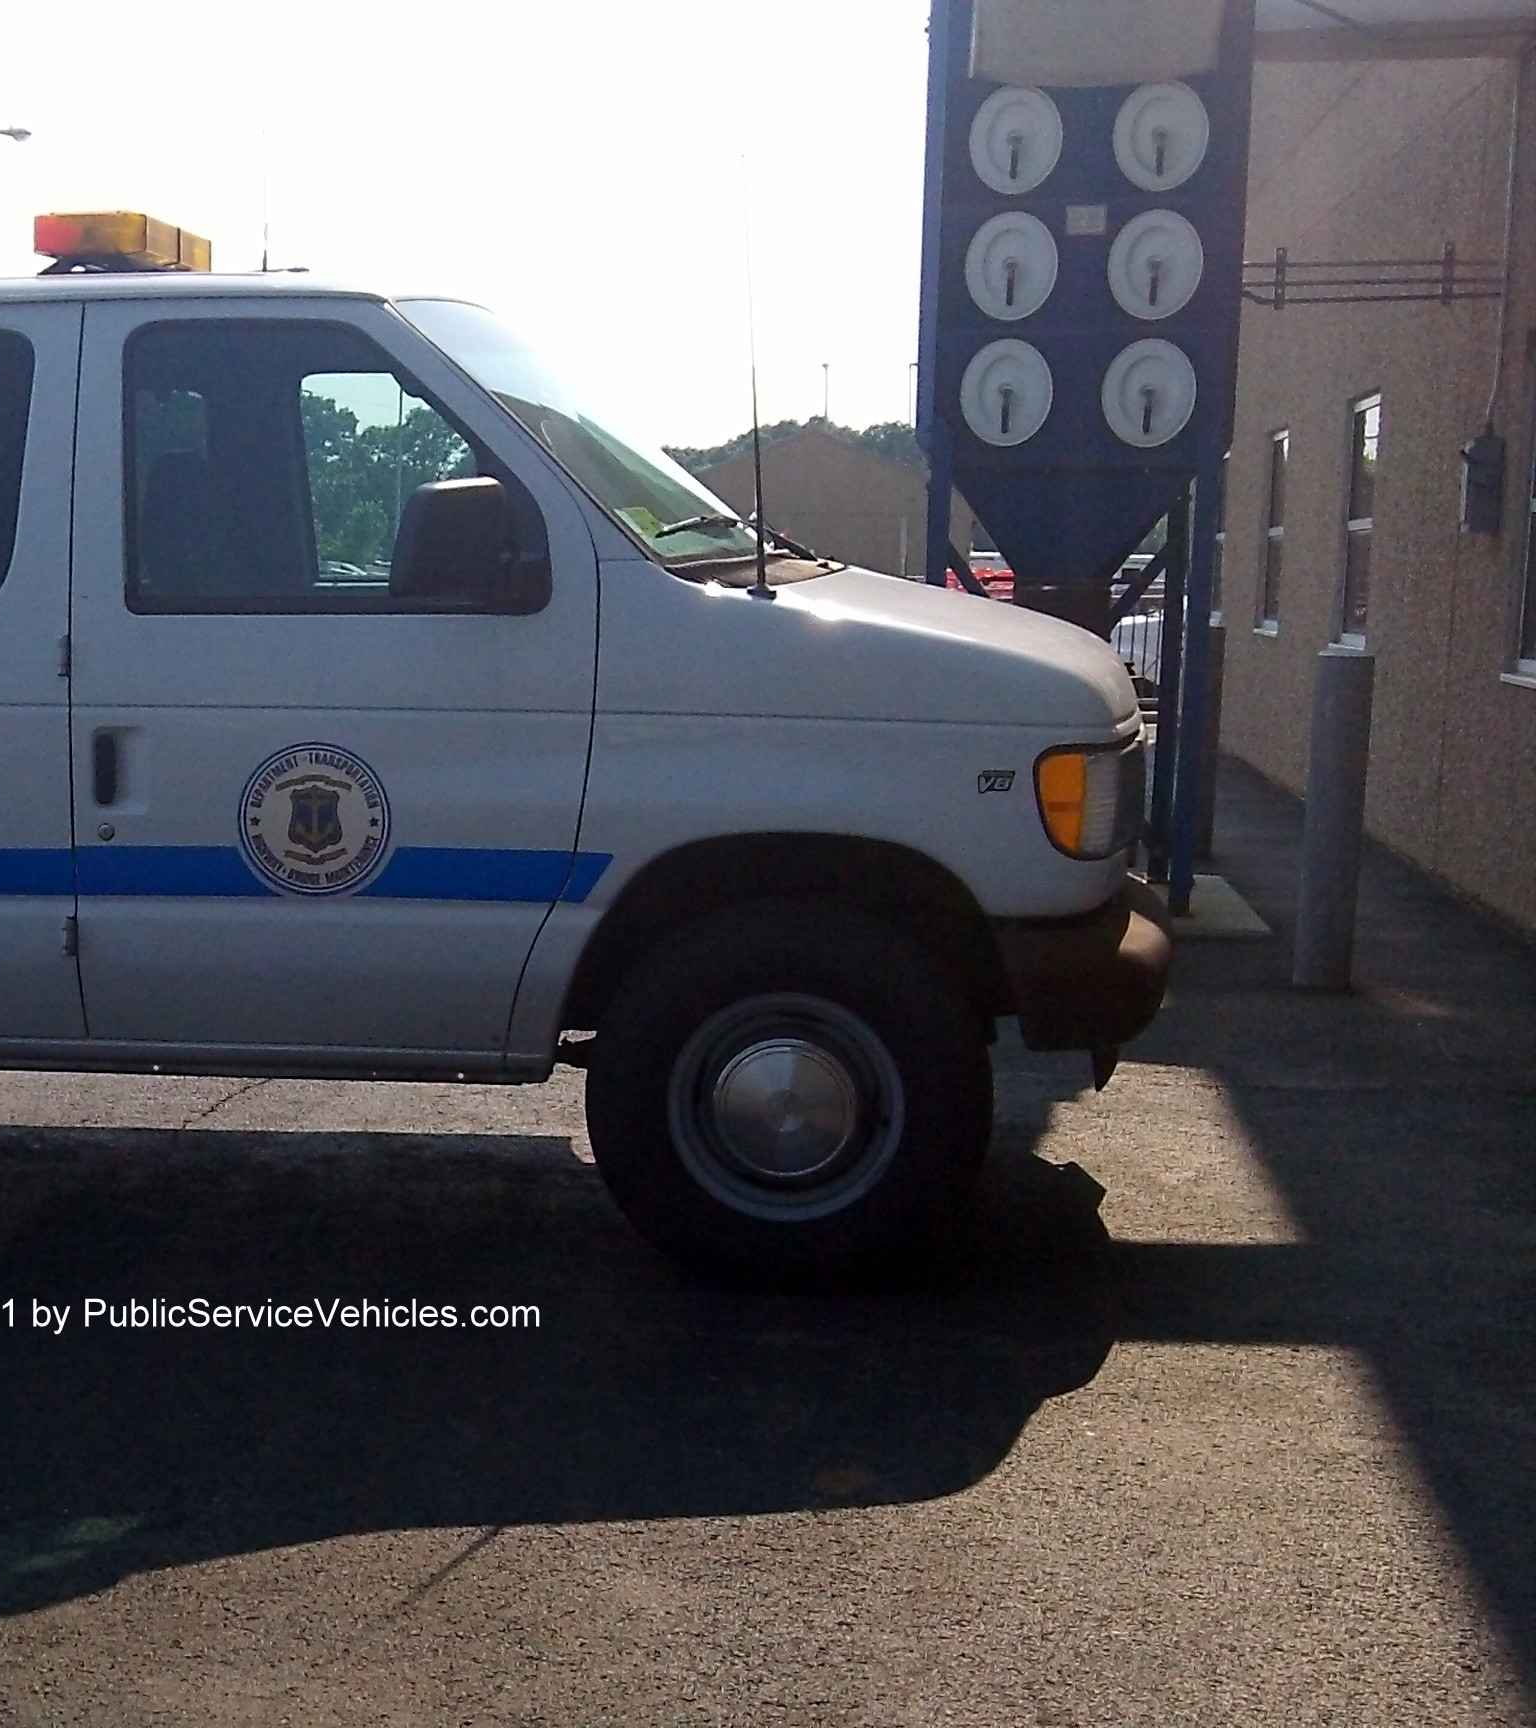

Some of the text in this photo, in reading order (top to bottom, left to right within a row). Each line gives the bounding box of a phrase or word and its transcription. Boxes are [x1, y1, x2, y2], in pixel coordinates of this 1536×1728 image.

[250, 752, 380, 809] DEPARTMENT TRANSPORTATION
[978, 775, 1013, 793] V8
